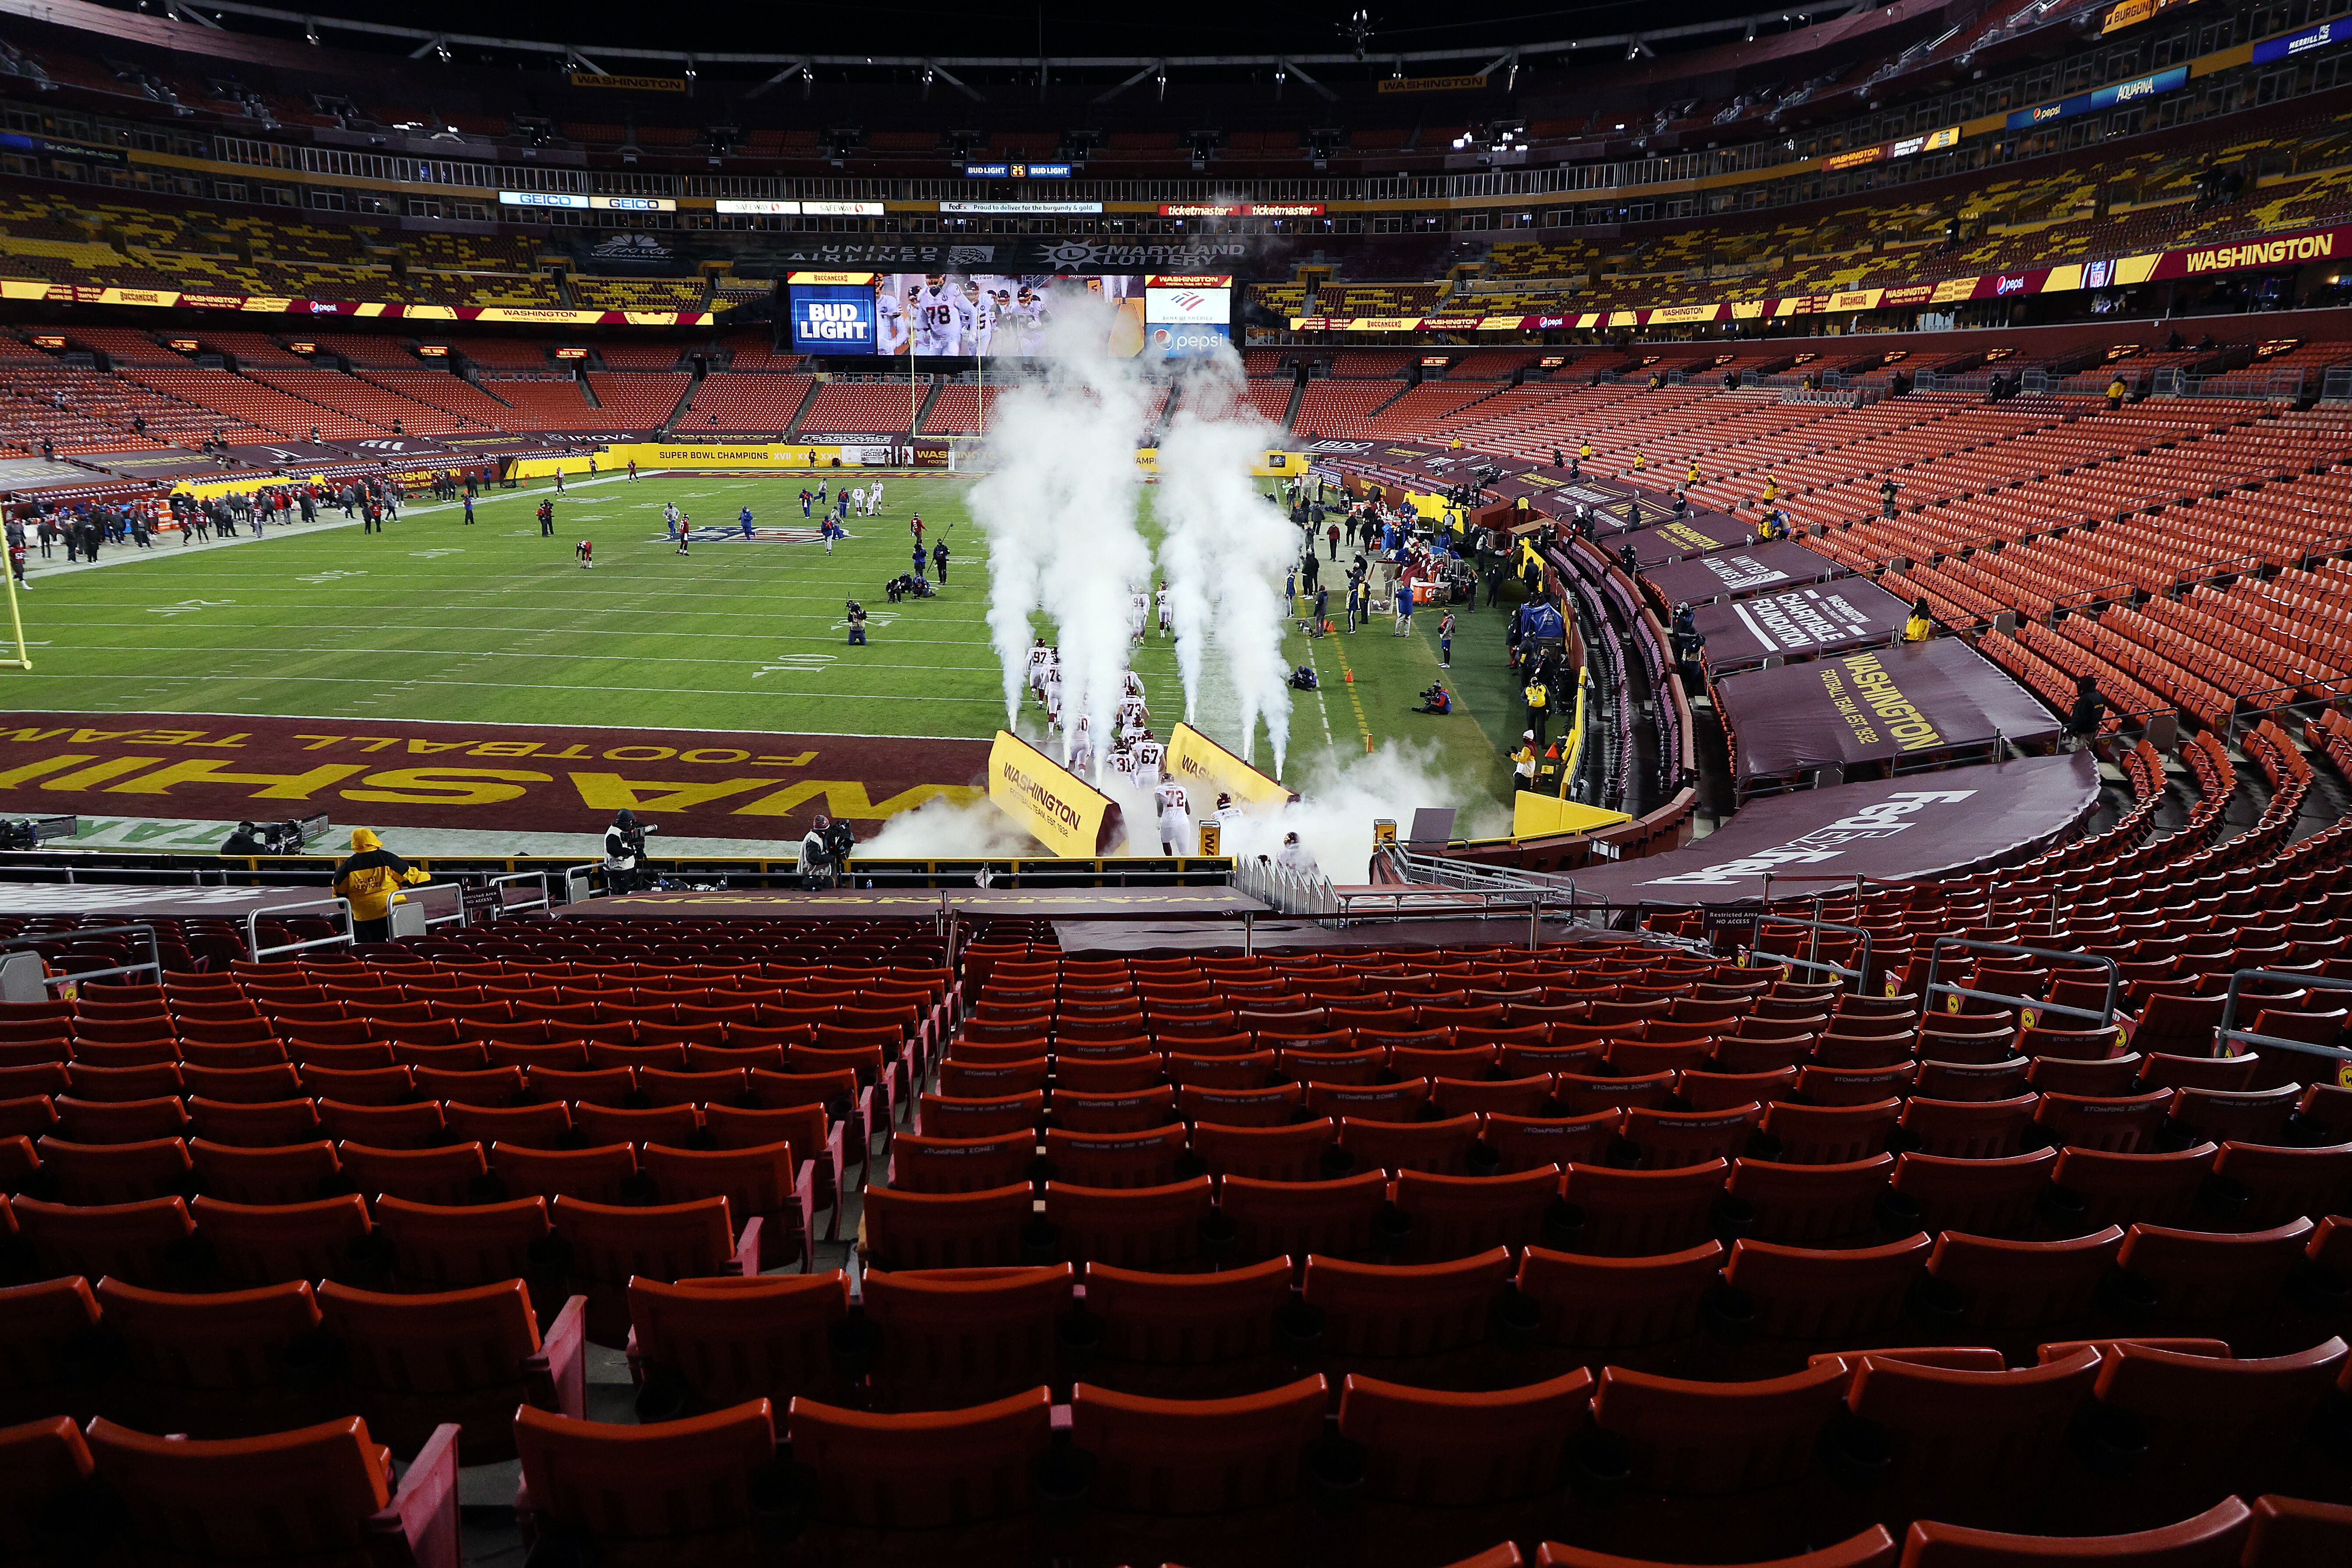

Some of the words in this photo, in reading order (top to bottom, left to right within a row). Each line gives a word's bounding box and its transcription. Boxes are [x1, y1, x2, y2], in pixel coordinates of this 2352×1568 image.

[577, 74, 681, 89] WASHINGTON
[1383, 76, 1485, 91] WASHINGTON
[2116, 78, 2154, 103] AQUAFINA
[2041, 104, 2061, 120] pepsi
[1829, 147, 1880, 165] WASHINGTON
[1012, 165, 1024, 176] 25
[520, 194, 571, 206] GEICO
[609, 198, 659, 210] GEICO
[1168, 205, 1229, 215] ticketmaster
[1252, 205, 1314, 215] ticketmaster
[787, 253, 936, 262] AIRLINES
[822, 245, 938, 254] UNITED
[1106, 244, 1245, 256] MARYLAND
[2186, 233, 2334, 273] WASHINGTON
[1104, 254, 1217, 266] LOTTERY
[1886, 285, 1931, 299] WASHINGTON
[2006, 276, 2024, 292] pepsi
[182, 295, 241, 304] WASHINGTON
[319, 303, 337, 312] pepsi
[809, 303, 858, 321] BUD
[926, 305, 951, 325] 78
[1662, 307, 1703, 317] WASHINGTON
[800, 321, 867, 339] LIGHT
[1547, 317, 1563, 327] pepsi
[1176, 332, 1223, 350] pepsi
[568, 433, 633, 442] INOVA
[1319, 442, 1375, 450] BDO
[1664, 521, 1725, 550] WASHINGTON
[1700, 556, 1745, 580] AIRLINES
[1729, 554, 1770, 574] UNITED
[1133, 597, 1144, 608] 94
[1825, 594, 1872, 624] WASHINGTON
[1748, 597, 1815, 648] FOUNDATION
[1775, 592, 1847, 642] CHARITABLE
[1033, 651, 1047, 664] 97
[1819, 668, 1847, 699] FOOTBALL
[1832, 695, 1860, 716] TEAM,
[1842, 652, 1945, 751] WASHINGTON
[1127, 703, 1141, 717] 73
[1844, 713, 1865, 729] EST.
[1853, 726, 1880, 745] 1932
[291, 733, 819, 766] FOOTBALL
[1141, 749, 1158, 764] 67
[1116, 757, 1132, 773] 31
[1004, 761, 1081, 831] WASHINGTON
[1165, 790, 1184, 807] 72
[1009, 787, 1034, 810] FOOTBALL
[1032, 804, 1047, 820] TEAM,
[1047, 815, 1057, 829] EST.
[1056, 822, 1069, 838] 1932
[968, 1145, 994, 1154] ZONE!
